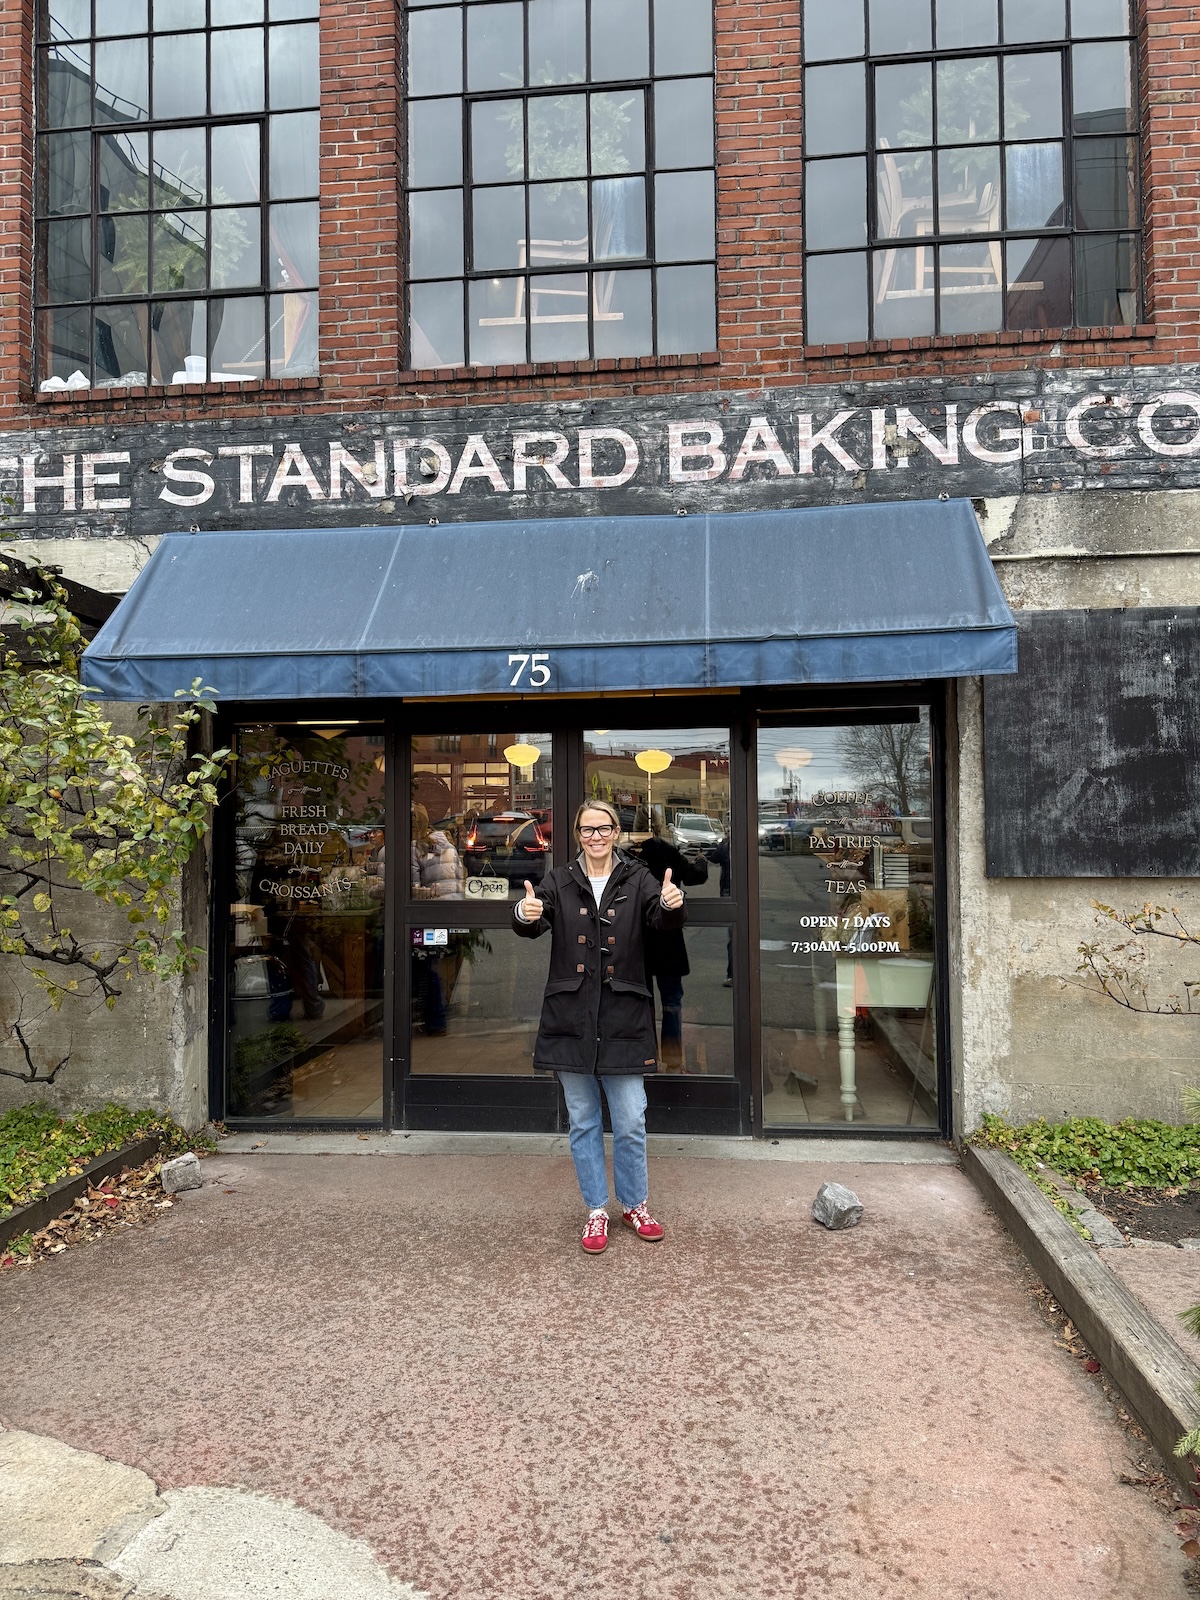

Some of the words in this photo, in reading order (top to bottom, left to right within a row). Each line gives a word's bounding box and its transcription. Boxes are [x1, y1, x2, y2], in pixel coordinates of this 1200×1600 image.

[158, 428, 639, 505] STANDARD
[667, 400, 1032, 483] BAKING
[508, 653, 551, 687] 75
[811, 790, 875, 807] COFFEE
[281, 805, 328, 818] FRESH
[280, 823, 329, 836] BREAD
[284, 841, 325, 855] DAILY
[809, 836, 881, 849] PASTRIES
[259, 877, 351, 899] CROISSANTS
[468, 879, 506, 898] Open
[824, 880, 868, 894] TEAS
[799, 916, 838, 928] OPEN
[841, 917, 850, 930] 7
[854, 916, 891, 928] DAYS
